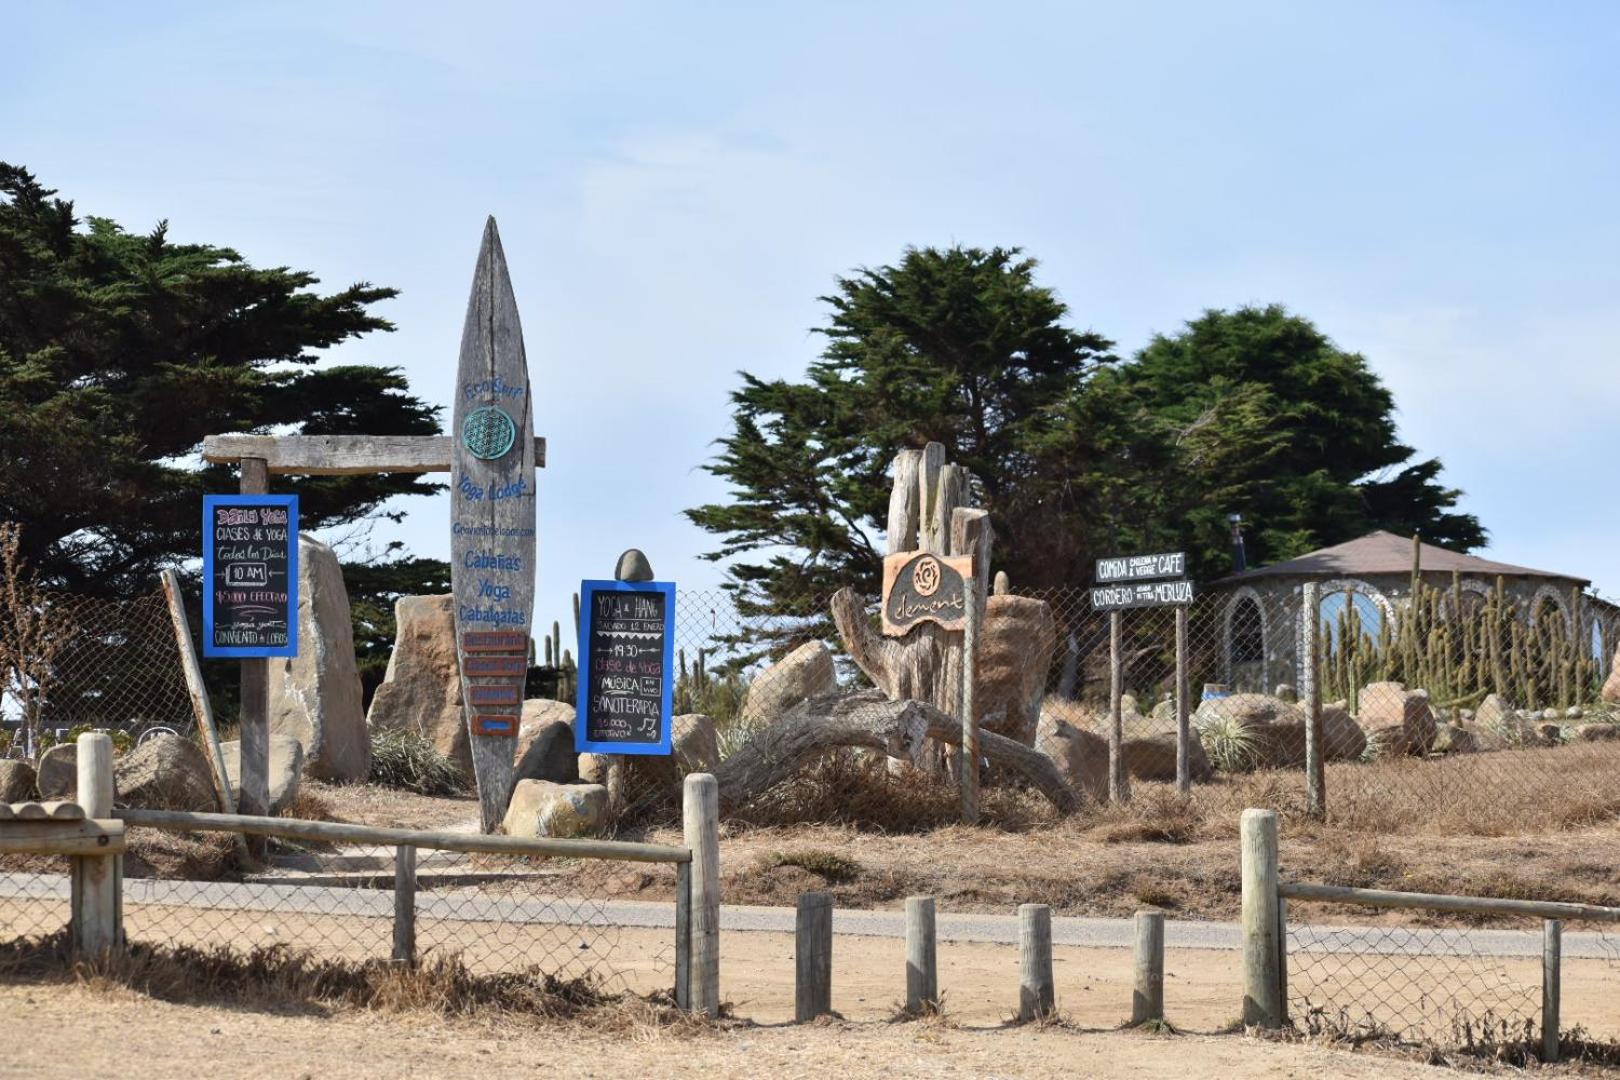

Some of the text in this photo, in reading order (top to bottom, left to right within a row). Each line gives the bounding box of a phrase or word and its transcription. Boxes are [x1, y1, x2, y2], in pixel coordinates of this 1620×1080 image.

[458, 472, 526, 501] Yoga Lodge
[266, 528, 287, 541] YOGA
[465, 550, 521, 571] Cabañas
[234, 567, 263, 579] 10 AM
[478, 579, 510, 602] Yoga
[1094, 582, 1194, 606] CORDERO MERLUZA
[460, 605, 526, 627] Cabalgatas
